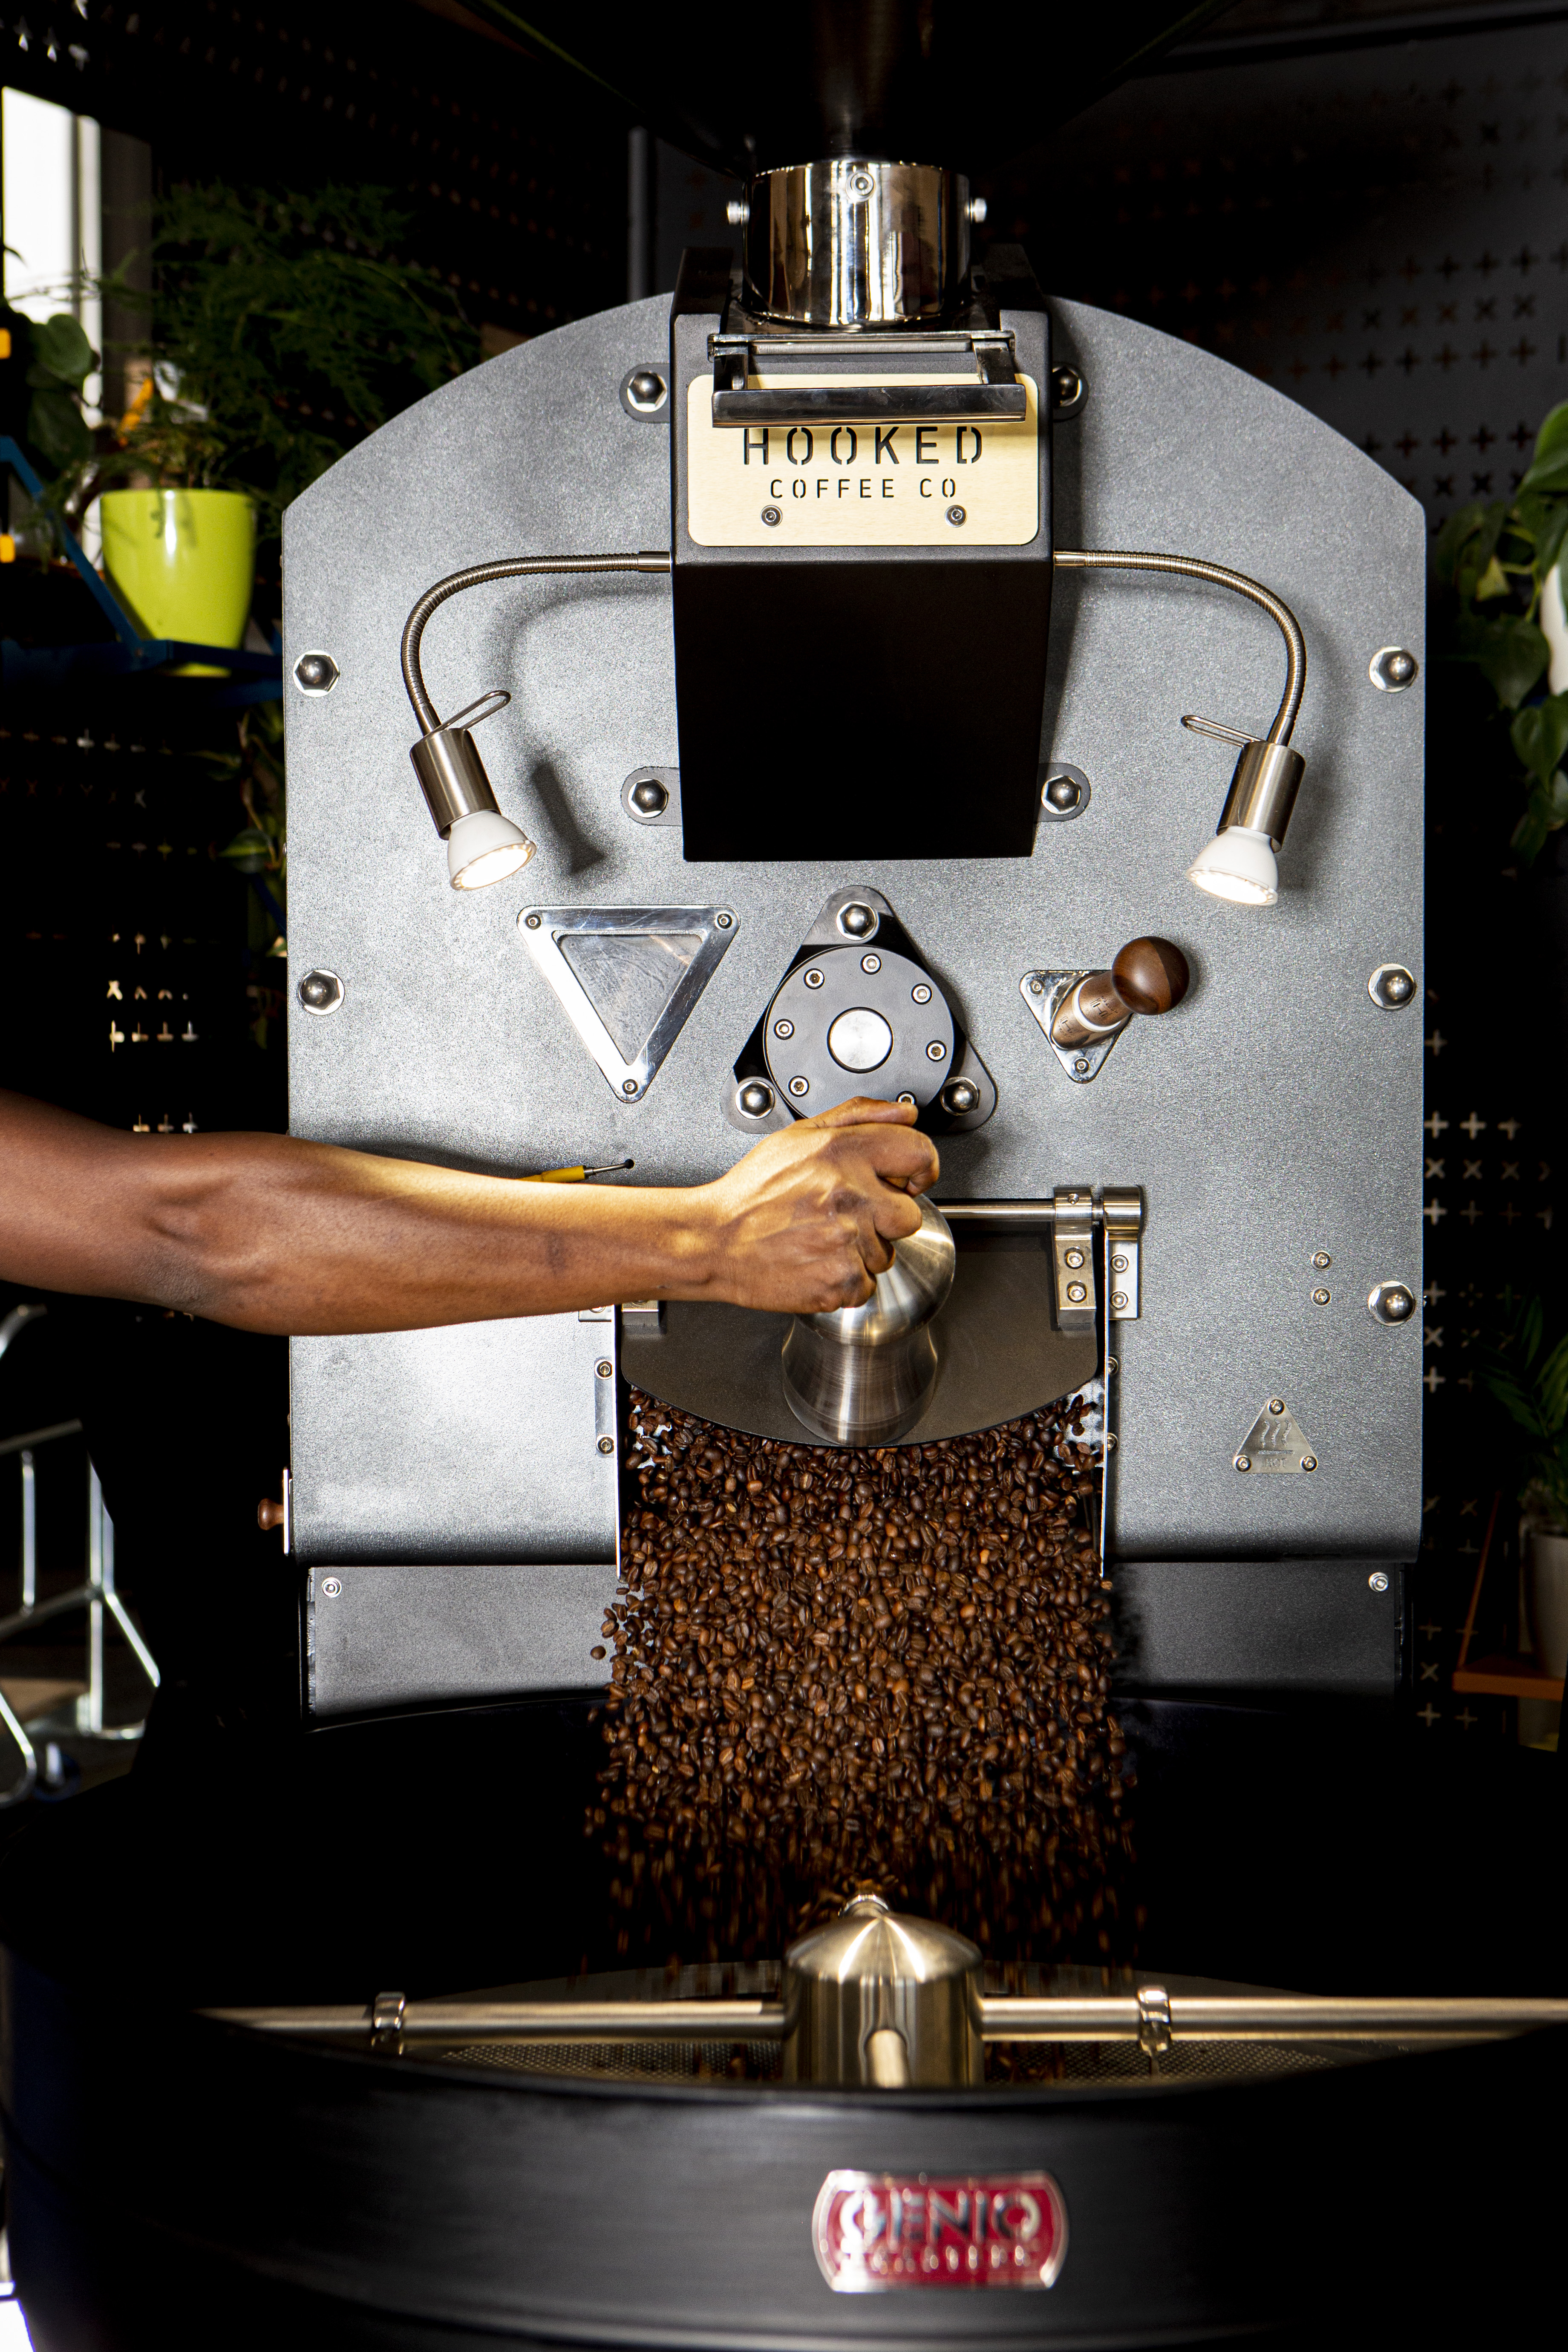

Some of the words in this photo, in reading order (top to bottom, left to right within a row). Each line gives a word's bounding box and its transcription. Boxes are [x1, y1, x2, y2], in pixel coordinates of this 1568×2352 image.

[744, 427, 983, 465] HOOKED
[770, 479, 894, 499] COFFEE
[919, 478, 956, 498] CO
[1265, 1457, 1287, 1467] HOT
[839, 2189, 1041, 2246] GENIO
